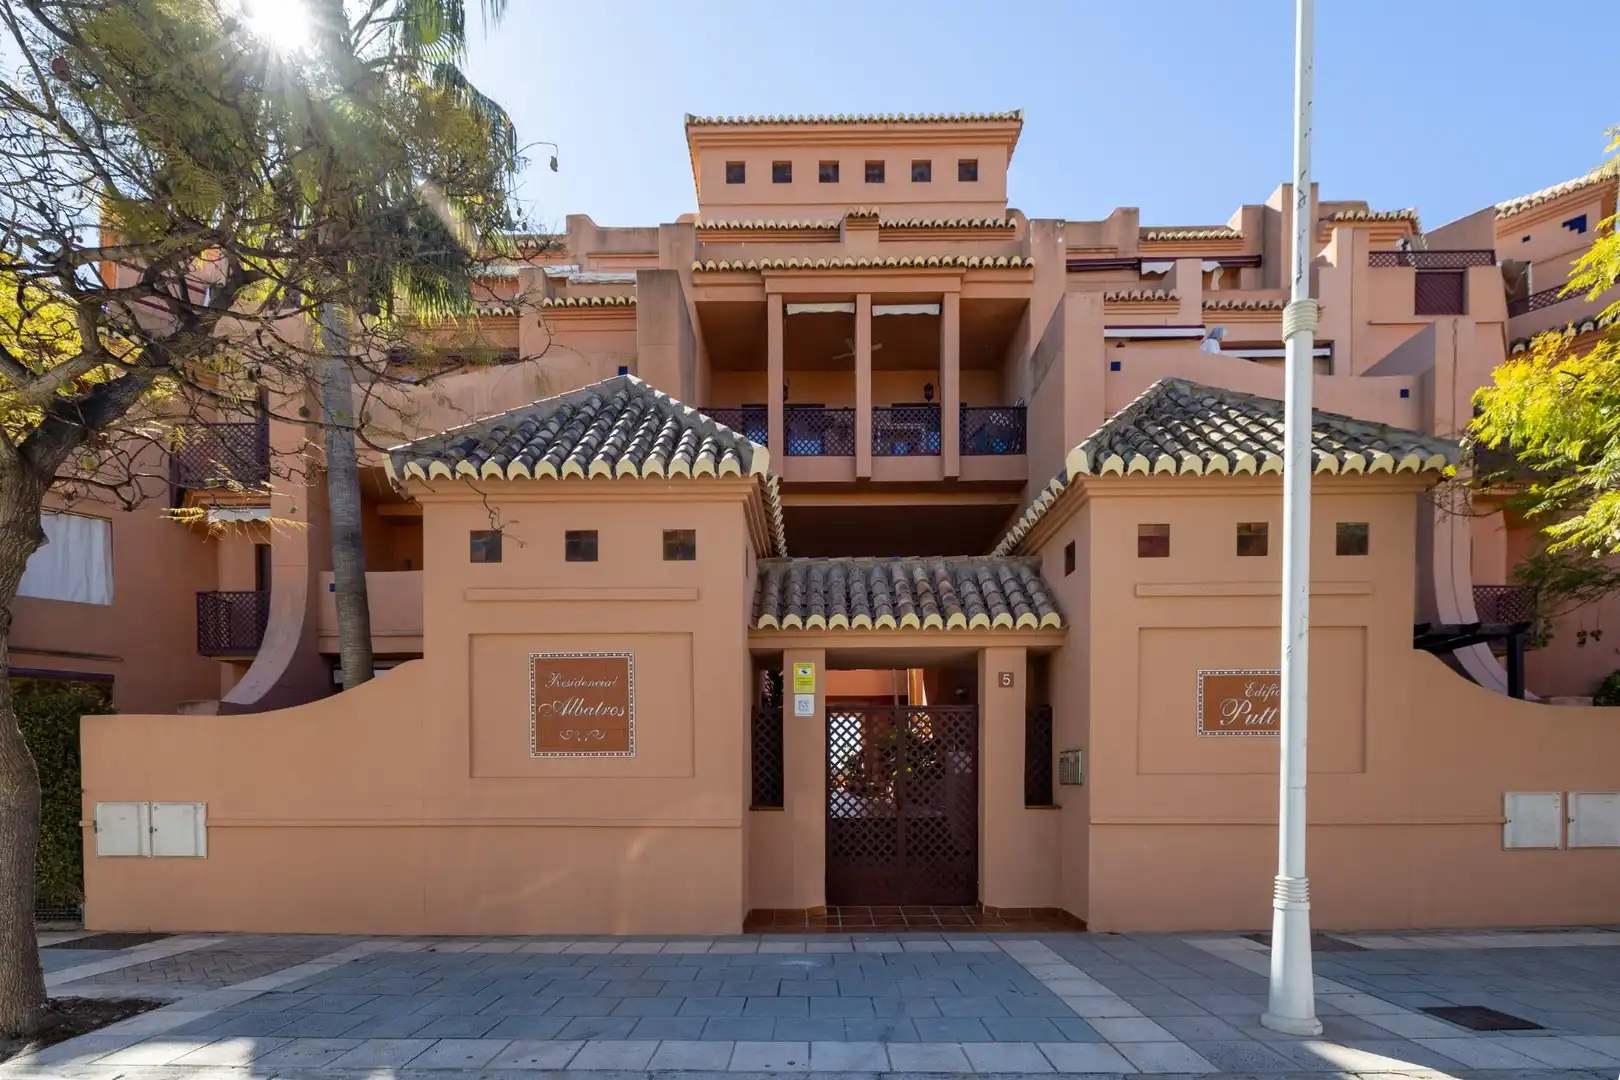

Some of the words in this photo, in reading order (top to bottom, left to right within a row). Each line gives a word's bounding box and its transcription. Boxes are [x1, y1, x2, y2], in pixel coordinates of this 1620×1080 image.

[545, 673, 619, 688] Residencial
[1003, 673, 1011, 686] 5
[1244, 680, 1281, 702] Edific
[538, 696, 625, 717] Albatros
[1219, 698, 1280, 726] Putt
